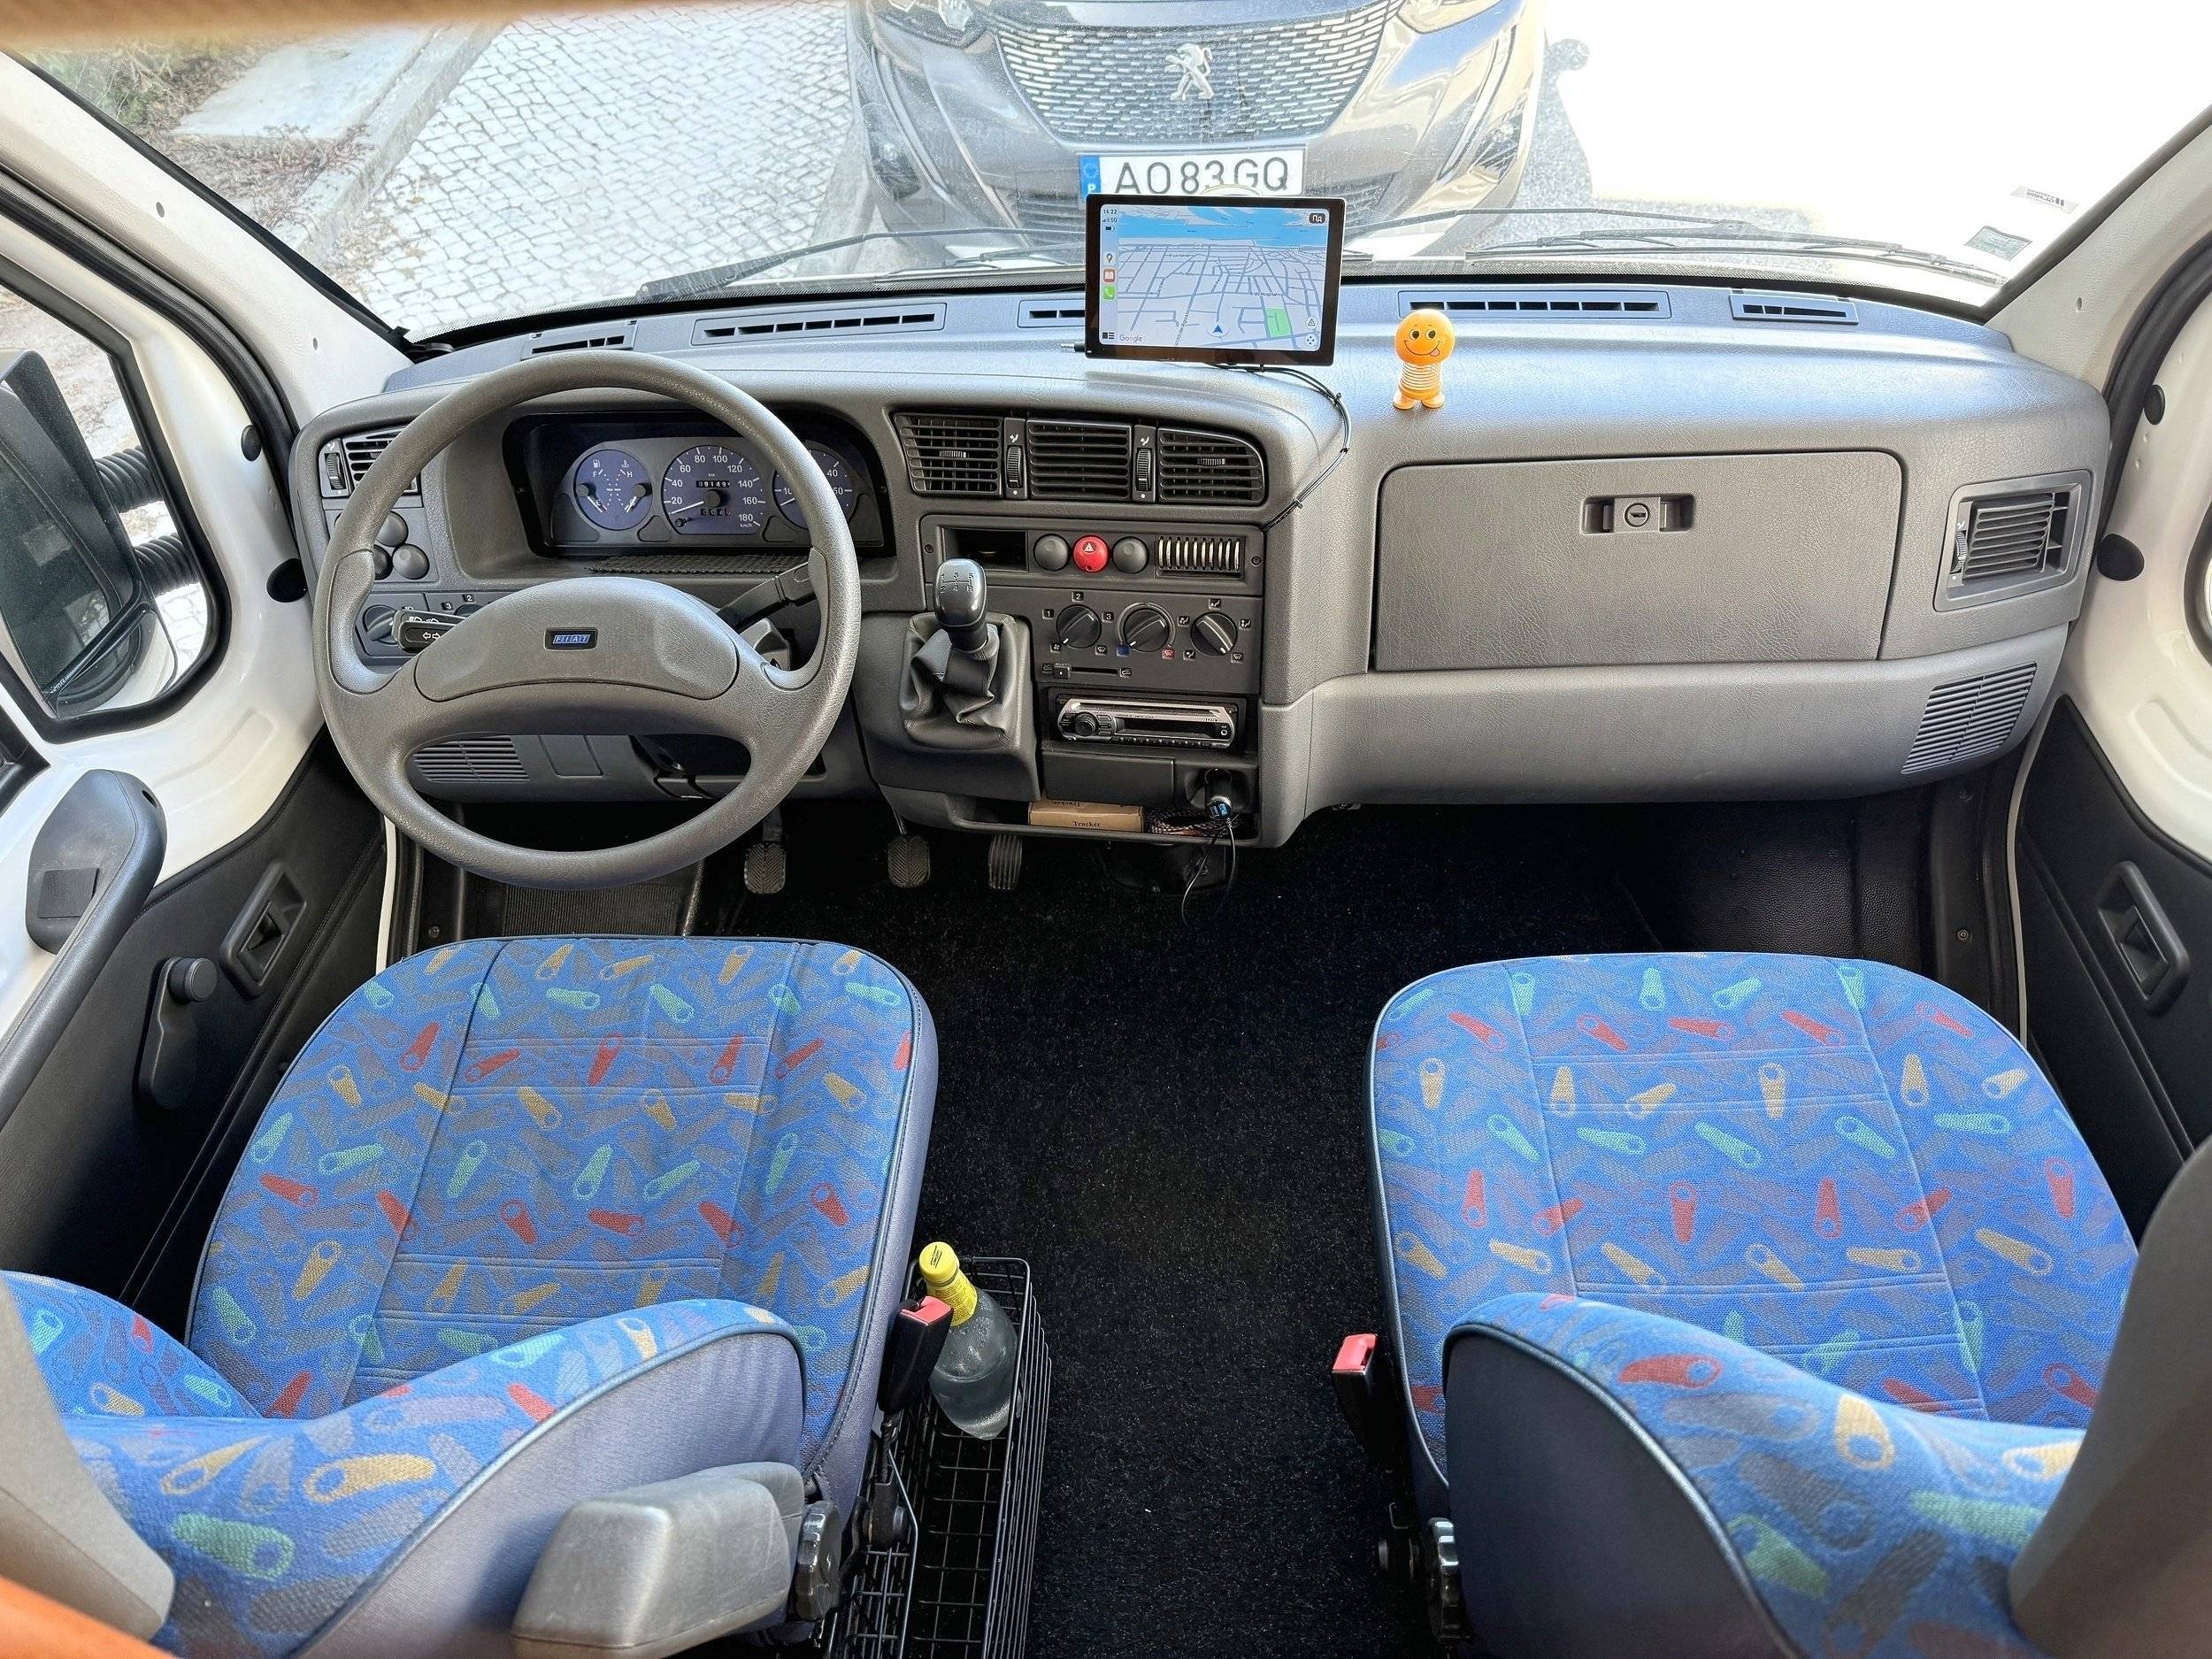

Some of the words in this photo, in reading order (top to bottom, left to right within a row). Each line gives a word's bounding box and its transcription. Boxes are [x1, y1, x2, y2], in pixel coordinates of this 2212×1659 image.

[1118, 334, 1143, 342] Google
[694, 455, 706, 464] 80
[712, 455, 728, 464] 100
[680, 465, 691, 473] 60
[727, 465, 743, 473] 120
[672, 479, 683, 488] 40
[671, 496, 683, 505] 20
[742, 496, 757, 505] 160
